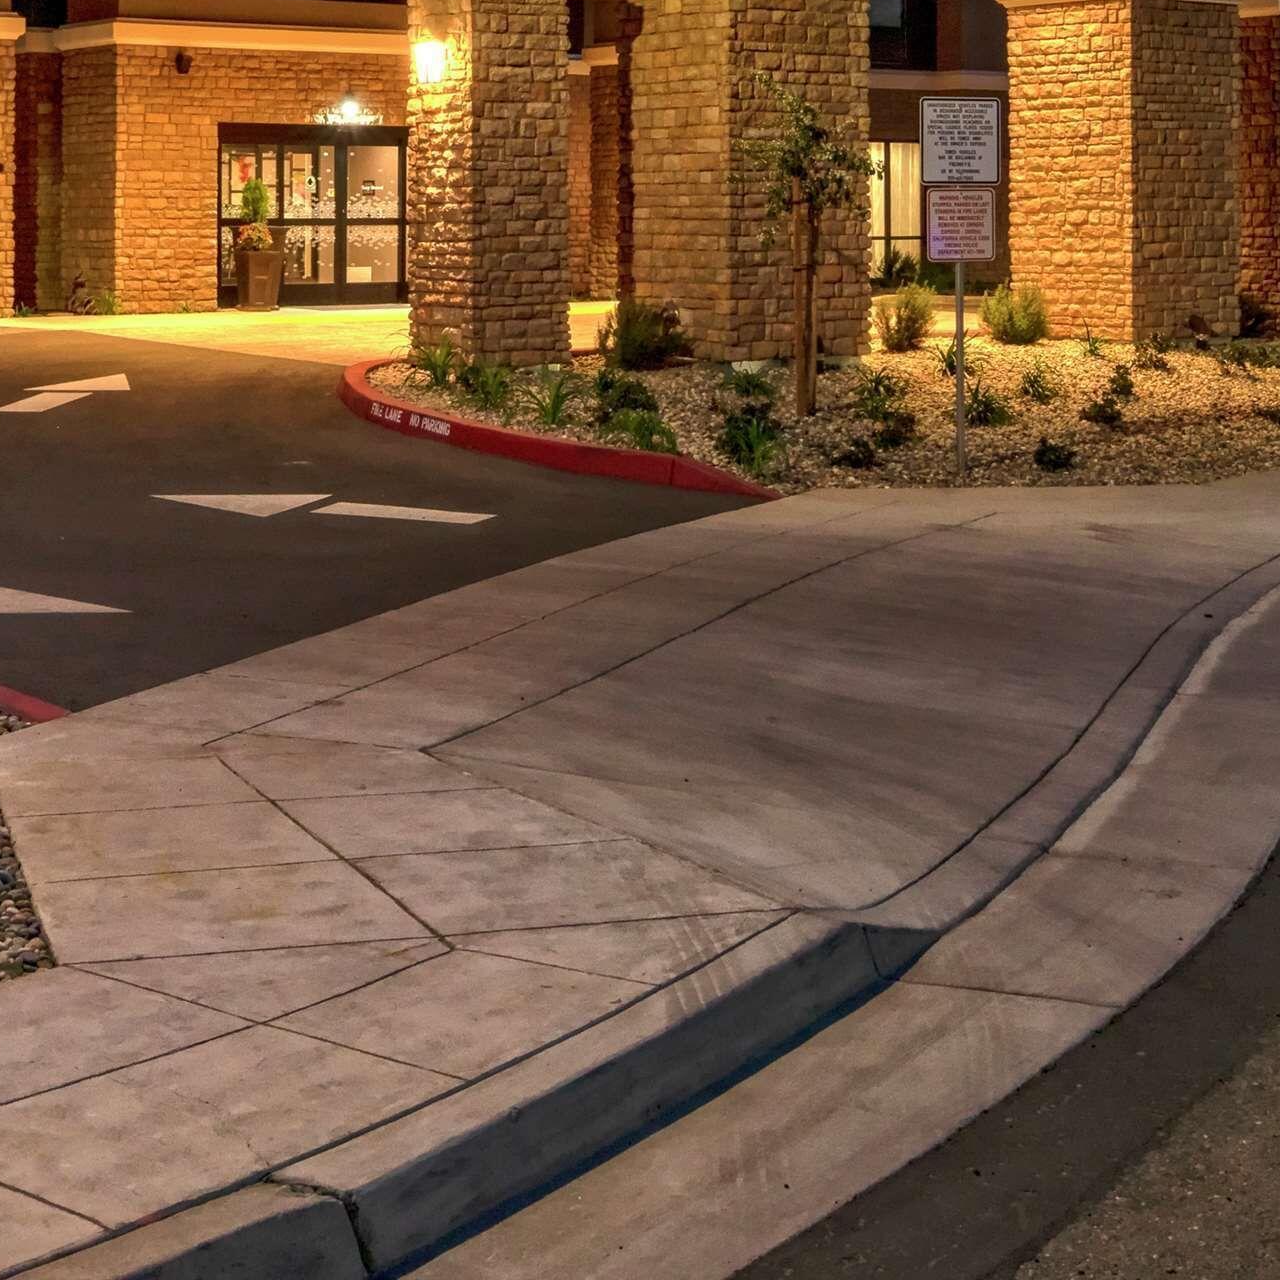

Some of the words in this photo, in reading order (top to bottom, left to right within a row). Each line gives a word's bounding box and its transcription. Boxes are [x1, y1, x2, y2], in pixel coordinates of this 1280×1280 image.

[384, 406, 403, 423] LANE
[410, 413, 420, 427] NO
[421, 417, 451, 436] PARKING
